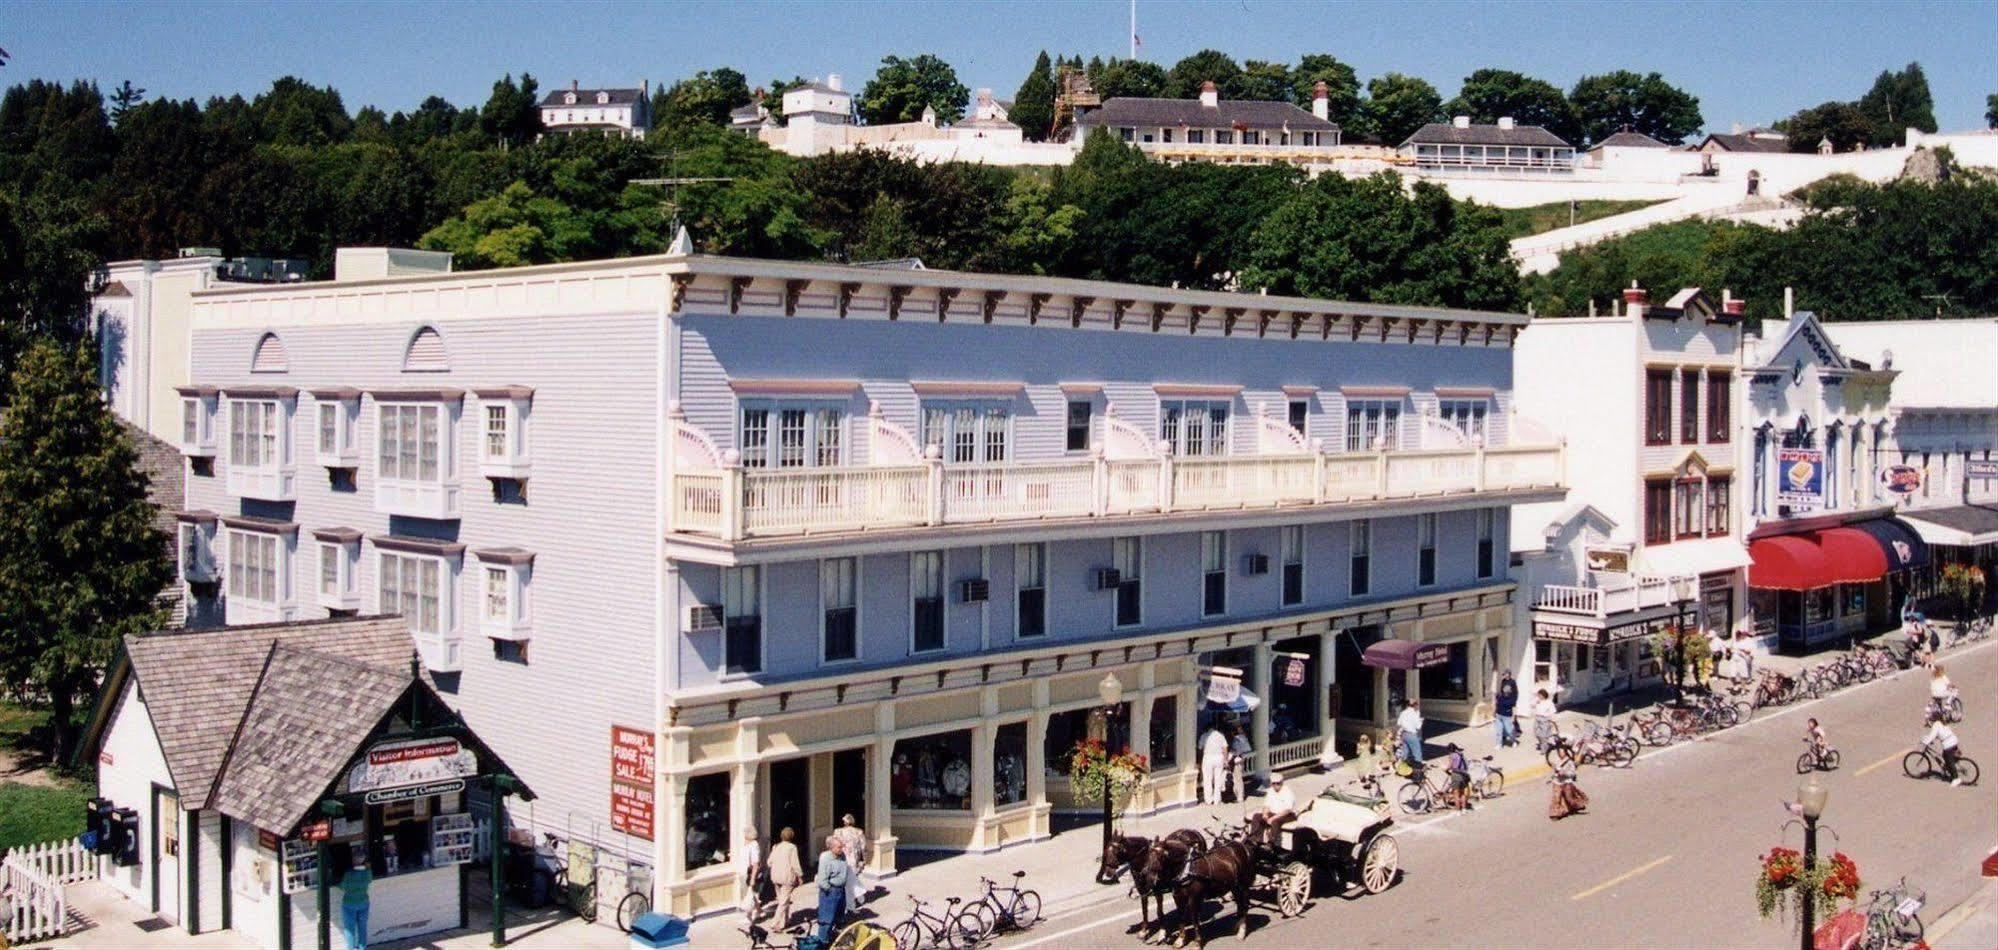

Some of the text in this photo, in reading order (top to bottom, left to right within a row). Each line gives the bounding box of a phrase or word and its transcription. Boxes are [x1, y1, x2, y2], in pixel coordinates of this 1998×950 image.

[371, 744, 458, 763] Visitor Information
[613, 745, 638, 763] FUDGE
[616, 762, 636, 779] SALE
[369, 782, 461, 801] Chamber of Commerce
